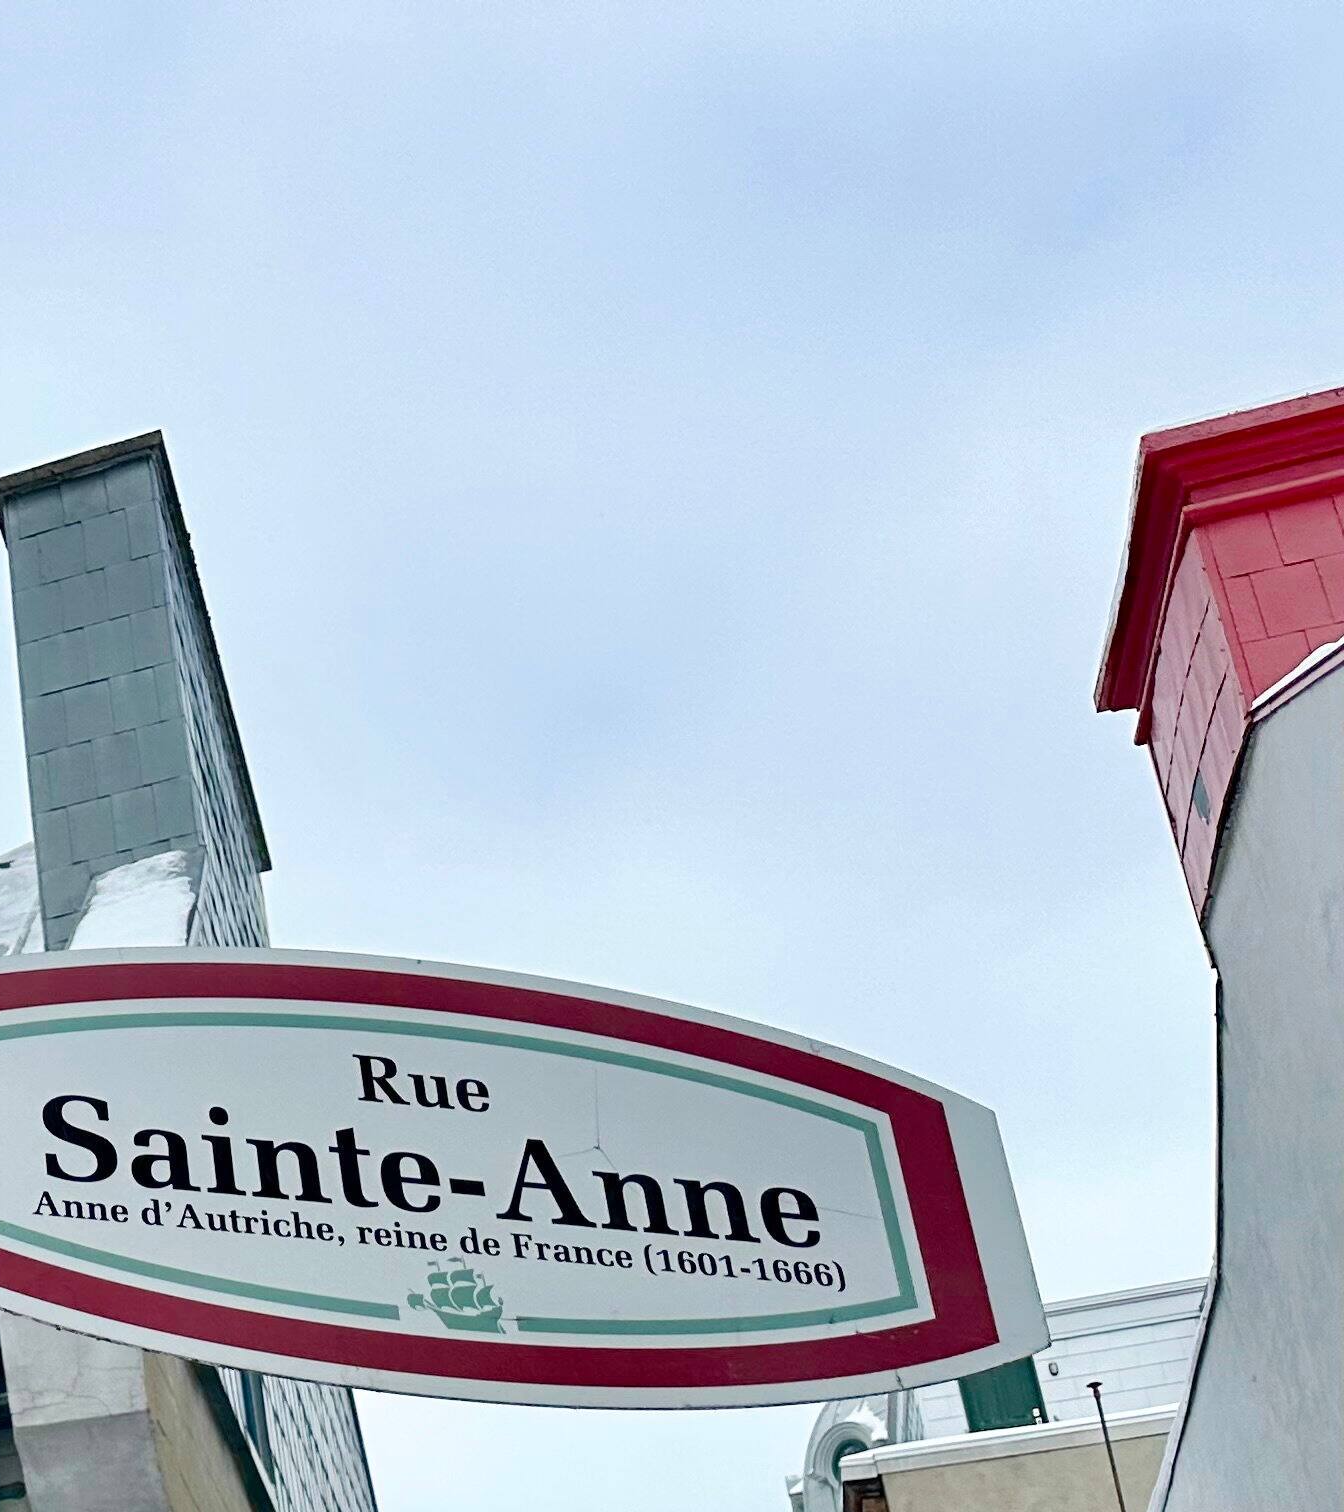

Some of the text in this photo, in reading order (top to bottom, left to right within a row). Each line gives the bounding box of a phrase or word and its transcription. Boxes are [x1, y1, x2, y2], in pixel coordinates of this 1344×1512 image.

[353, 1054, 489, 1112] Rue
[42, 1095, 821, 1248] Sainte-Anne
[33, 1191, 129, 1222] Anne
[357, 1222, 447, 1252] reine
[460, 1227, 500, 1256] de
[511, 1232, 633, 1268] France
[643, 1244, 847, 1292] (1601-1666)
